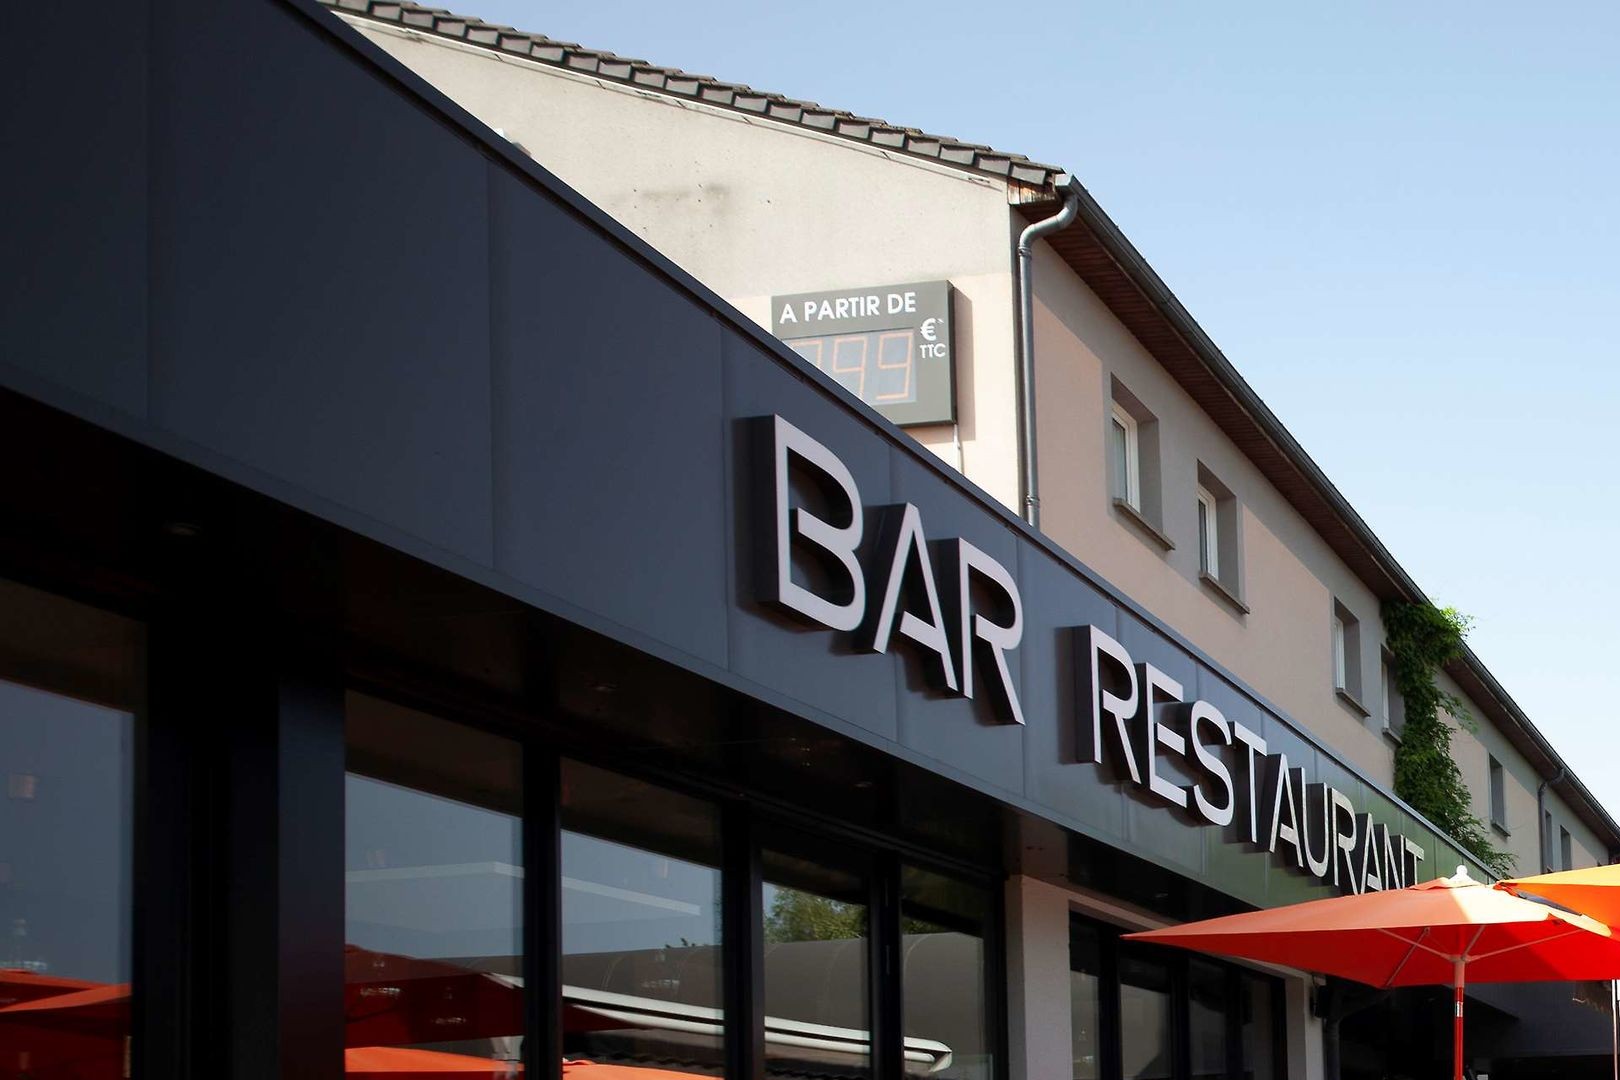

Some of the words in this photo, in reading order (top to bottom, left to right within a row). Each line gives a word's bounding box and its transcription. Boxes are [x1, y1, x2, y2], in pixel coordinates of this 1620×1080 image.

[779, 303, 798, 324] A
[804, 296, 880, 322] PARTIR
[887, 292, 916, 314] DE
[919, 343, 946, 359] TTC
[774, 414, 1025, 726] BAR
[1089, 624, 1425, 896] RESTAURANT
